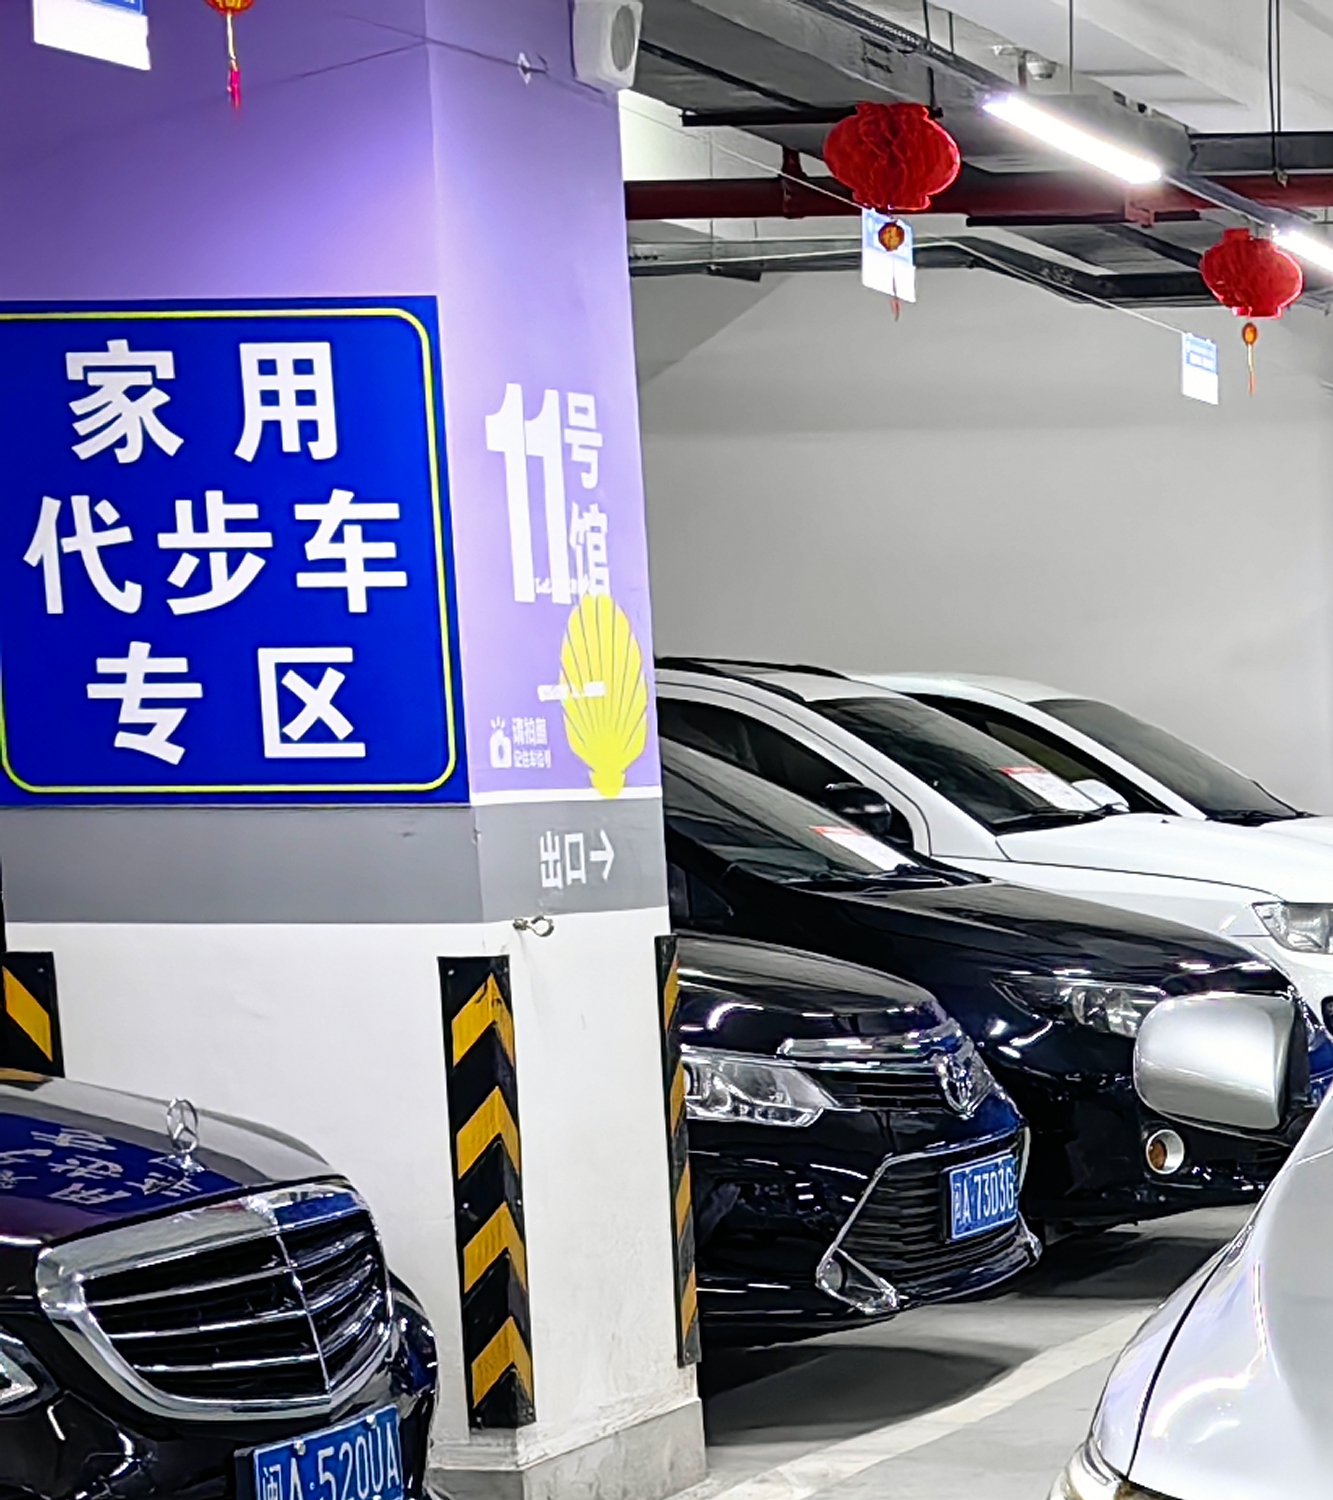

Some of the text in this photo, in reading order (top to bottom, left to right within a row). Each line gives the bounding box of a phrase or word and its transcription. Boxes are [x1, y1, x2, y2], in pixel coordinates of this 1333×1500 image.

[65, 338, 339, 464] 家用
[22, 488, 408, 616] 代步车
[485, 383, 573, 604] 11
[86, 640, 367, 766] 专区
[539, 830, 587, 889] 出口
